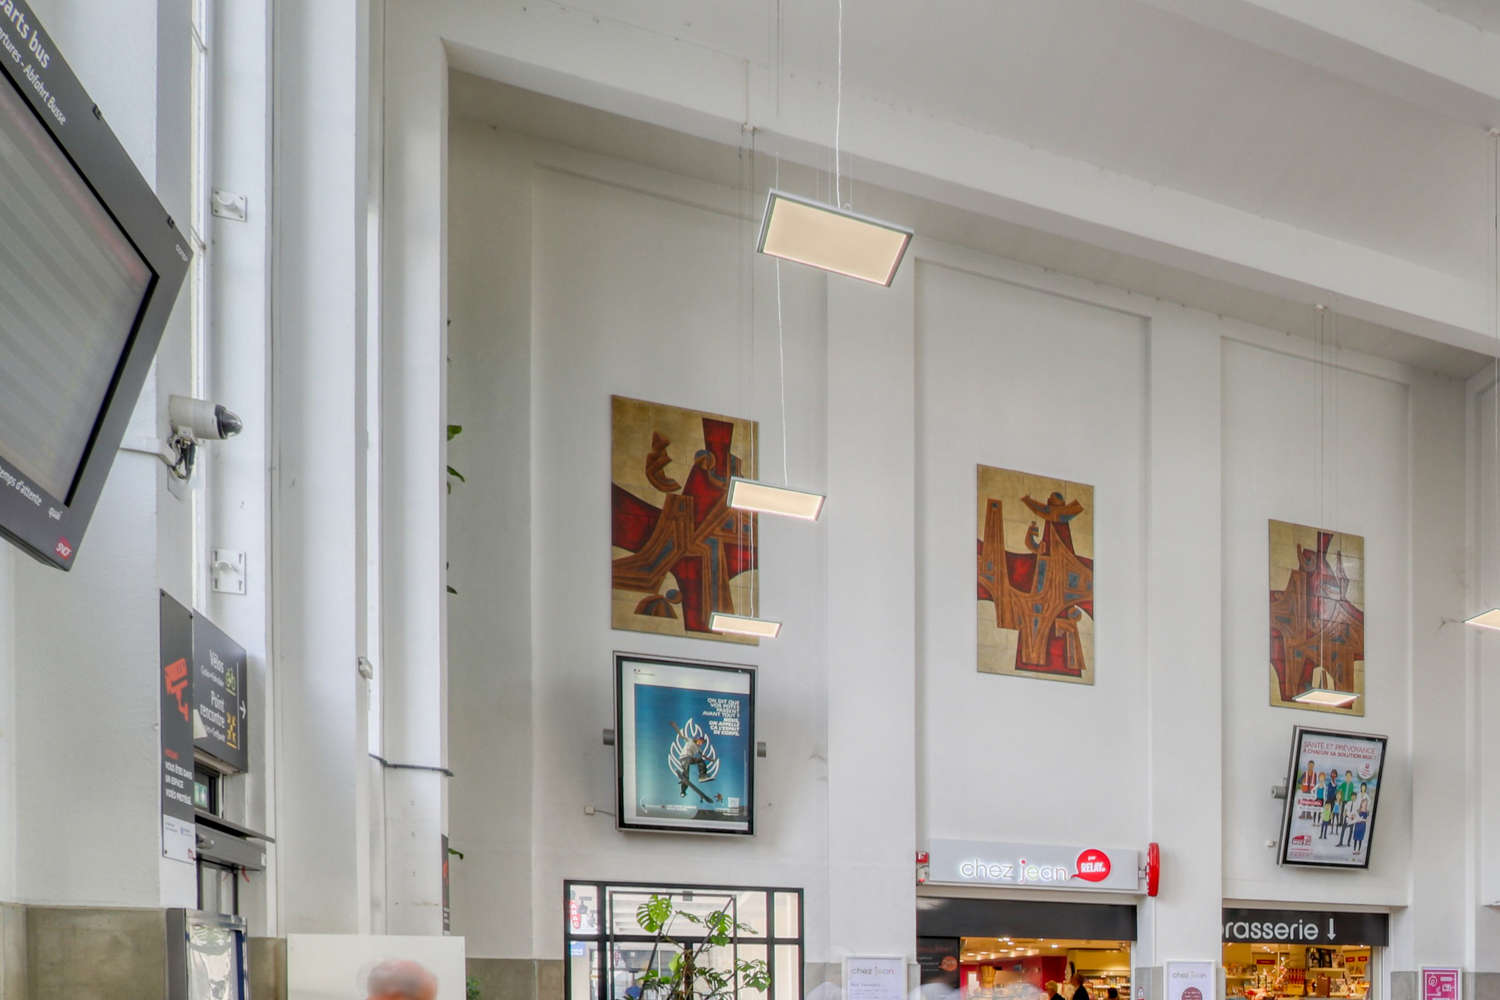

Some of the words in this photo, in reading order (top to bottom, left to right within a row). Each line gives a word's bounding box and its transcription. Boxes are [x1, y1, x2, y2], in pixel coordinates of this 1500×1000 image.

[29, 30, 50, 69] bus
[23, 64, 50, 102] Abfahrt
[47, 96, 66, 125] Busse
[15, 480, 42, 507] d'attente
[48, 507, 63, 520] quai
[56, 543, 72, 556] SNCF
[209, 649, 224, 673] Vélos
[211, 689, 225, 713] Point
[200, 703, 225, 729] rencontre
[1303, 741, 1324, 749] SANTÉ
[1335, 744, 1376, 755] PRÉVOYANCE
[165, 761, 175, 773] VOUS
[175, 763, 183, 776] ÊTES
[183, 768, 193, 780] DANS
[165, 774, 171, 783] UN
[171, 777, 184, 789] ESPACE
[165, 788, 176, 800] VIDÉO
[960, 858, 1014, 879] chez
[1018, 859, 1068, 884] jean
[1222, 919, 1319, 941] rasserie
[851, 966, 873, 975] chez
[874, 966, 894, 976] jean
[1190, 971, 1207, 980] jean
